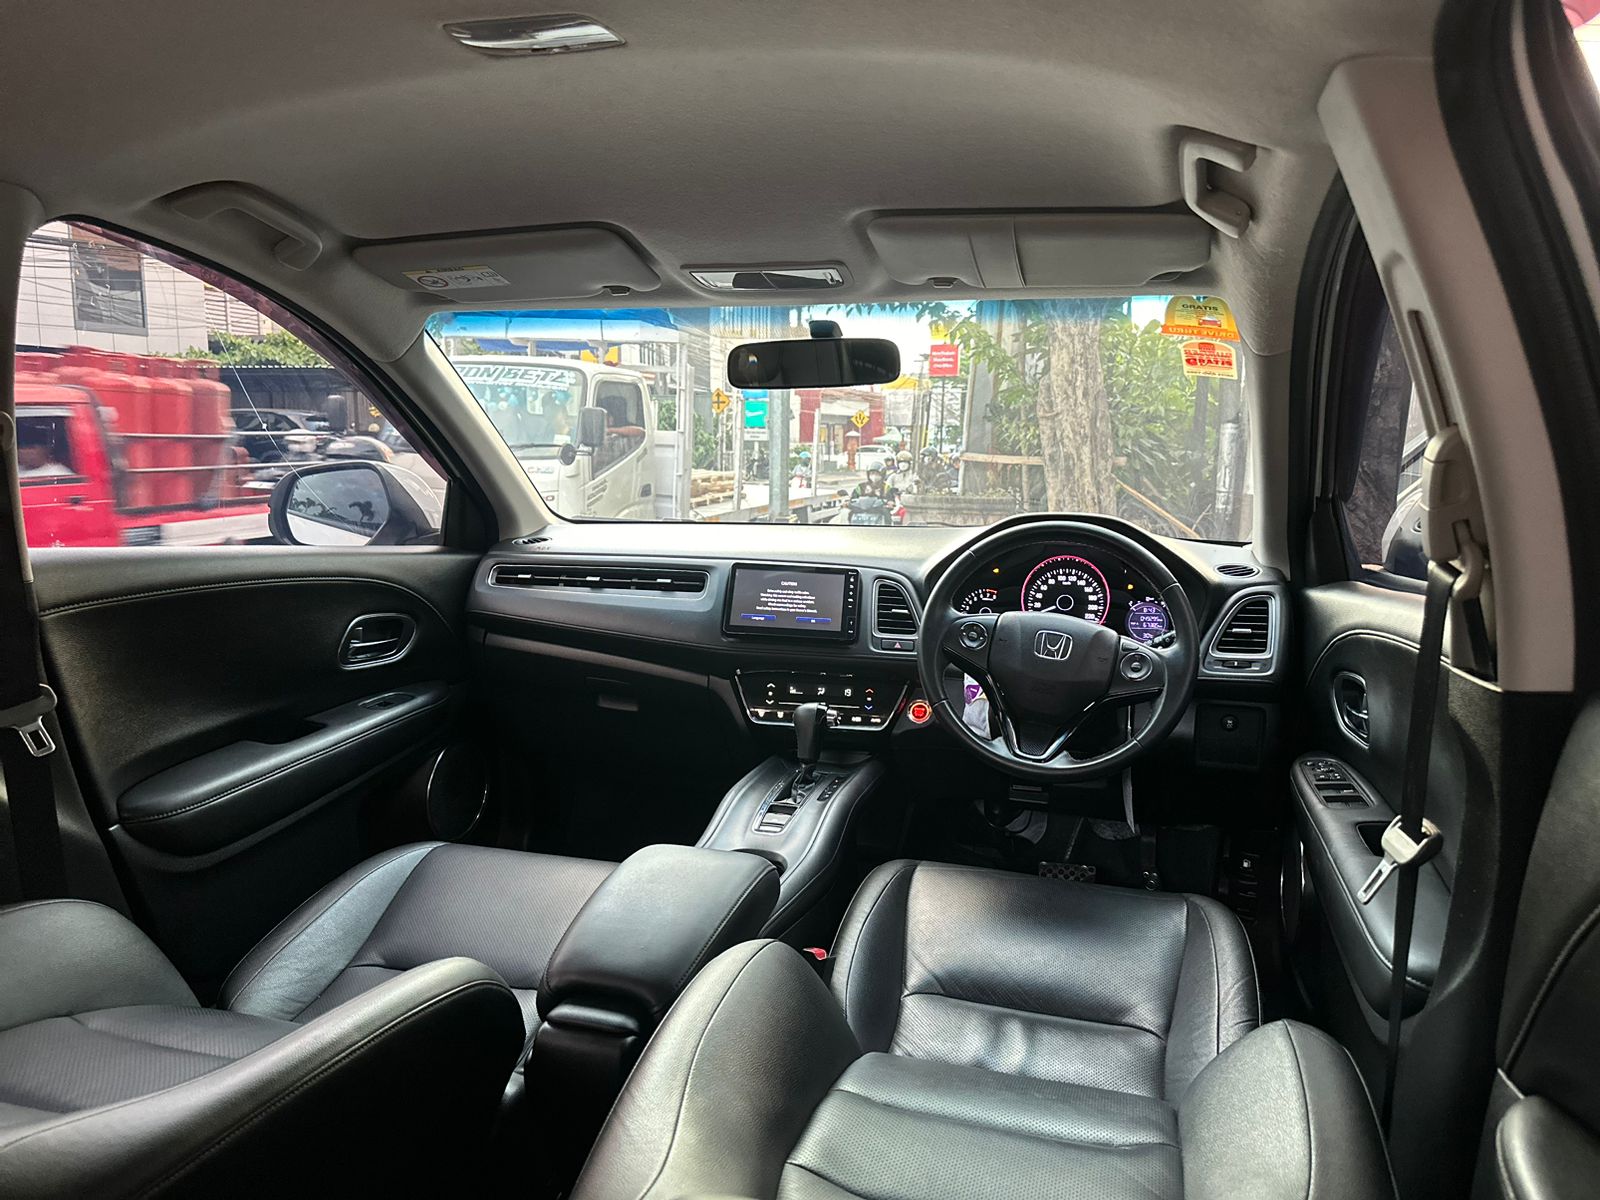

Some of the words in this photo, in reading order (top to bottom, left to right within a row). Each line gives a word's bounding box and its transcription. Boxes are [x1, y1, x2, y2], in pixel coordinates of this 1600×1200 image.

[1181, 303, 1218, 311] GRATIS
[1185, 358, 1232, 367] GRATIS
[844, 688, 852, 697] 19
